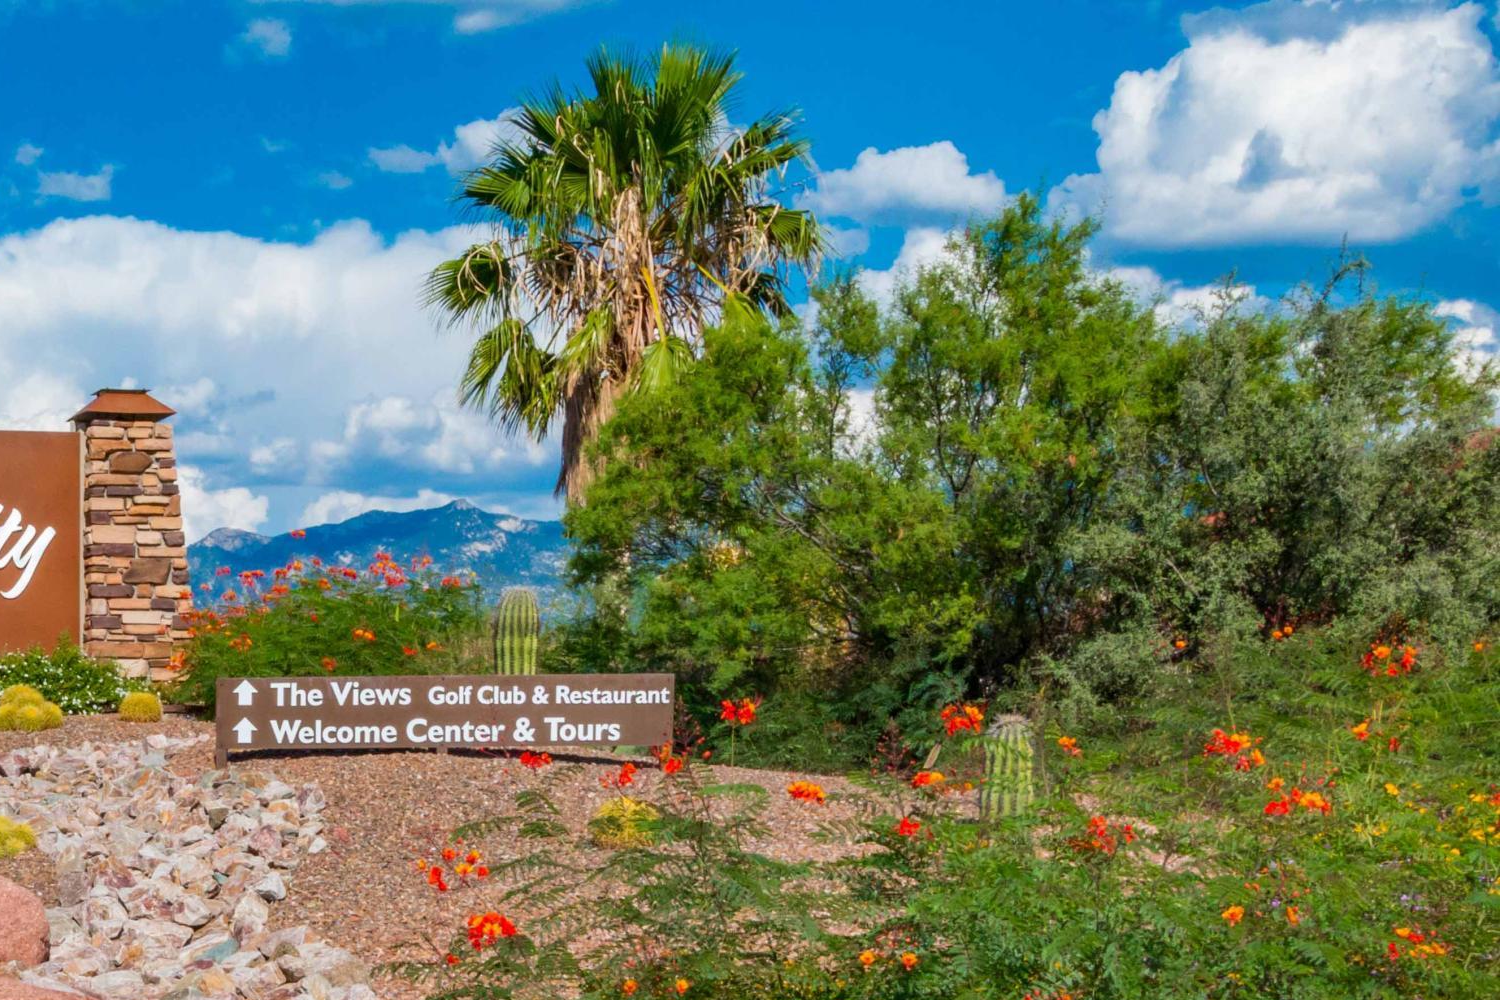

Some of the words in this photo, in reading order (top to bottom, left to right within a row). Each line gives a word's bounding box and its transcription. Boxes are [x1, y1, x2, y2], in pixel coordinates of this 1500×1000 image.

[270, 682, 323, 706] The
[331, 681, 412, 706] Views
[428, 685, 472, 705] Golf
[477, 685, 527, 705] Club
[532, 685, 550, 705] &
[555, 685, 670, 705] Restaurant
[270, 719, 398, 744] Welcome
[406, 718, 505, 743] Center
[513, 717, 536, 742] &
[544, 716, 621, 742] Tours
